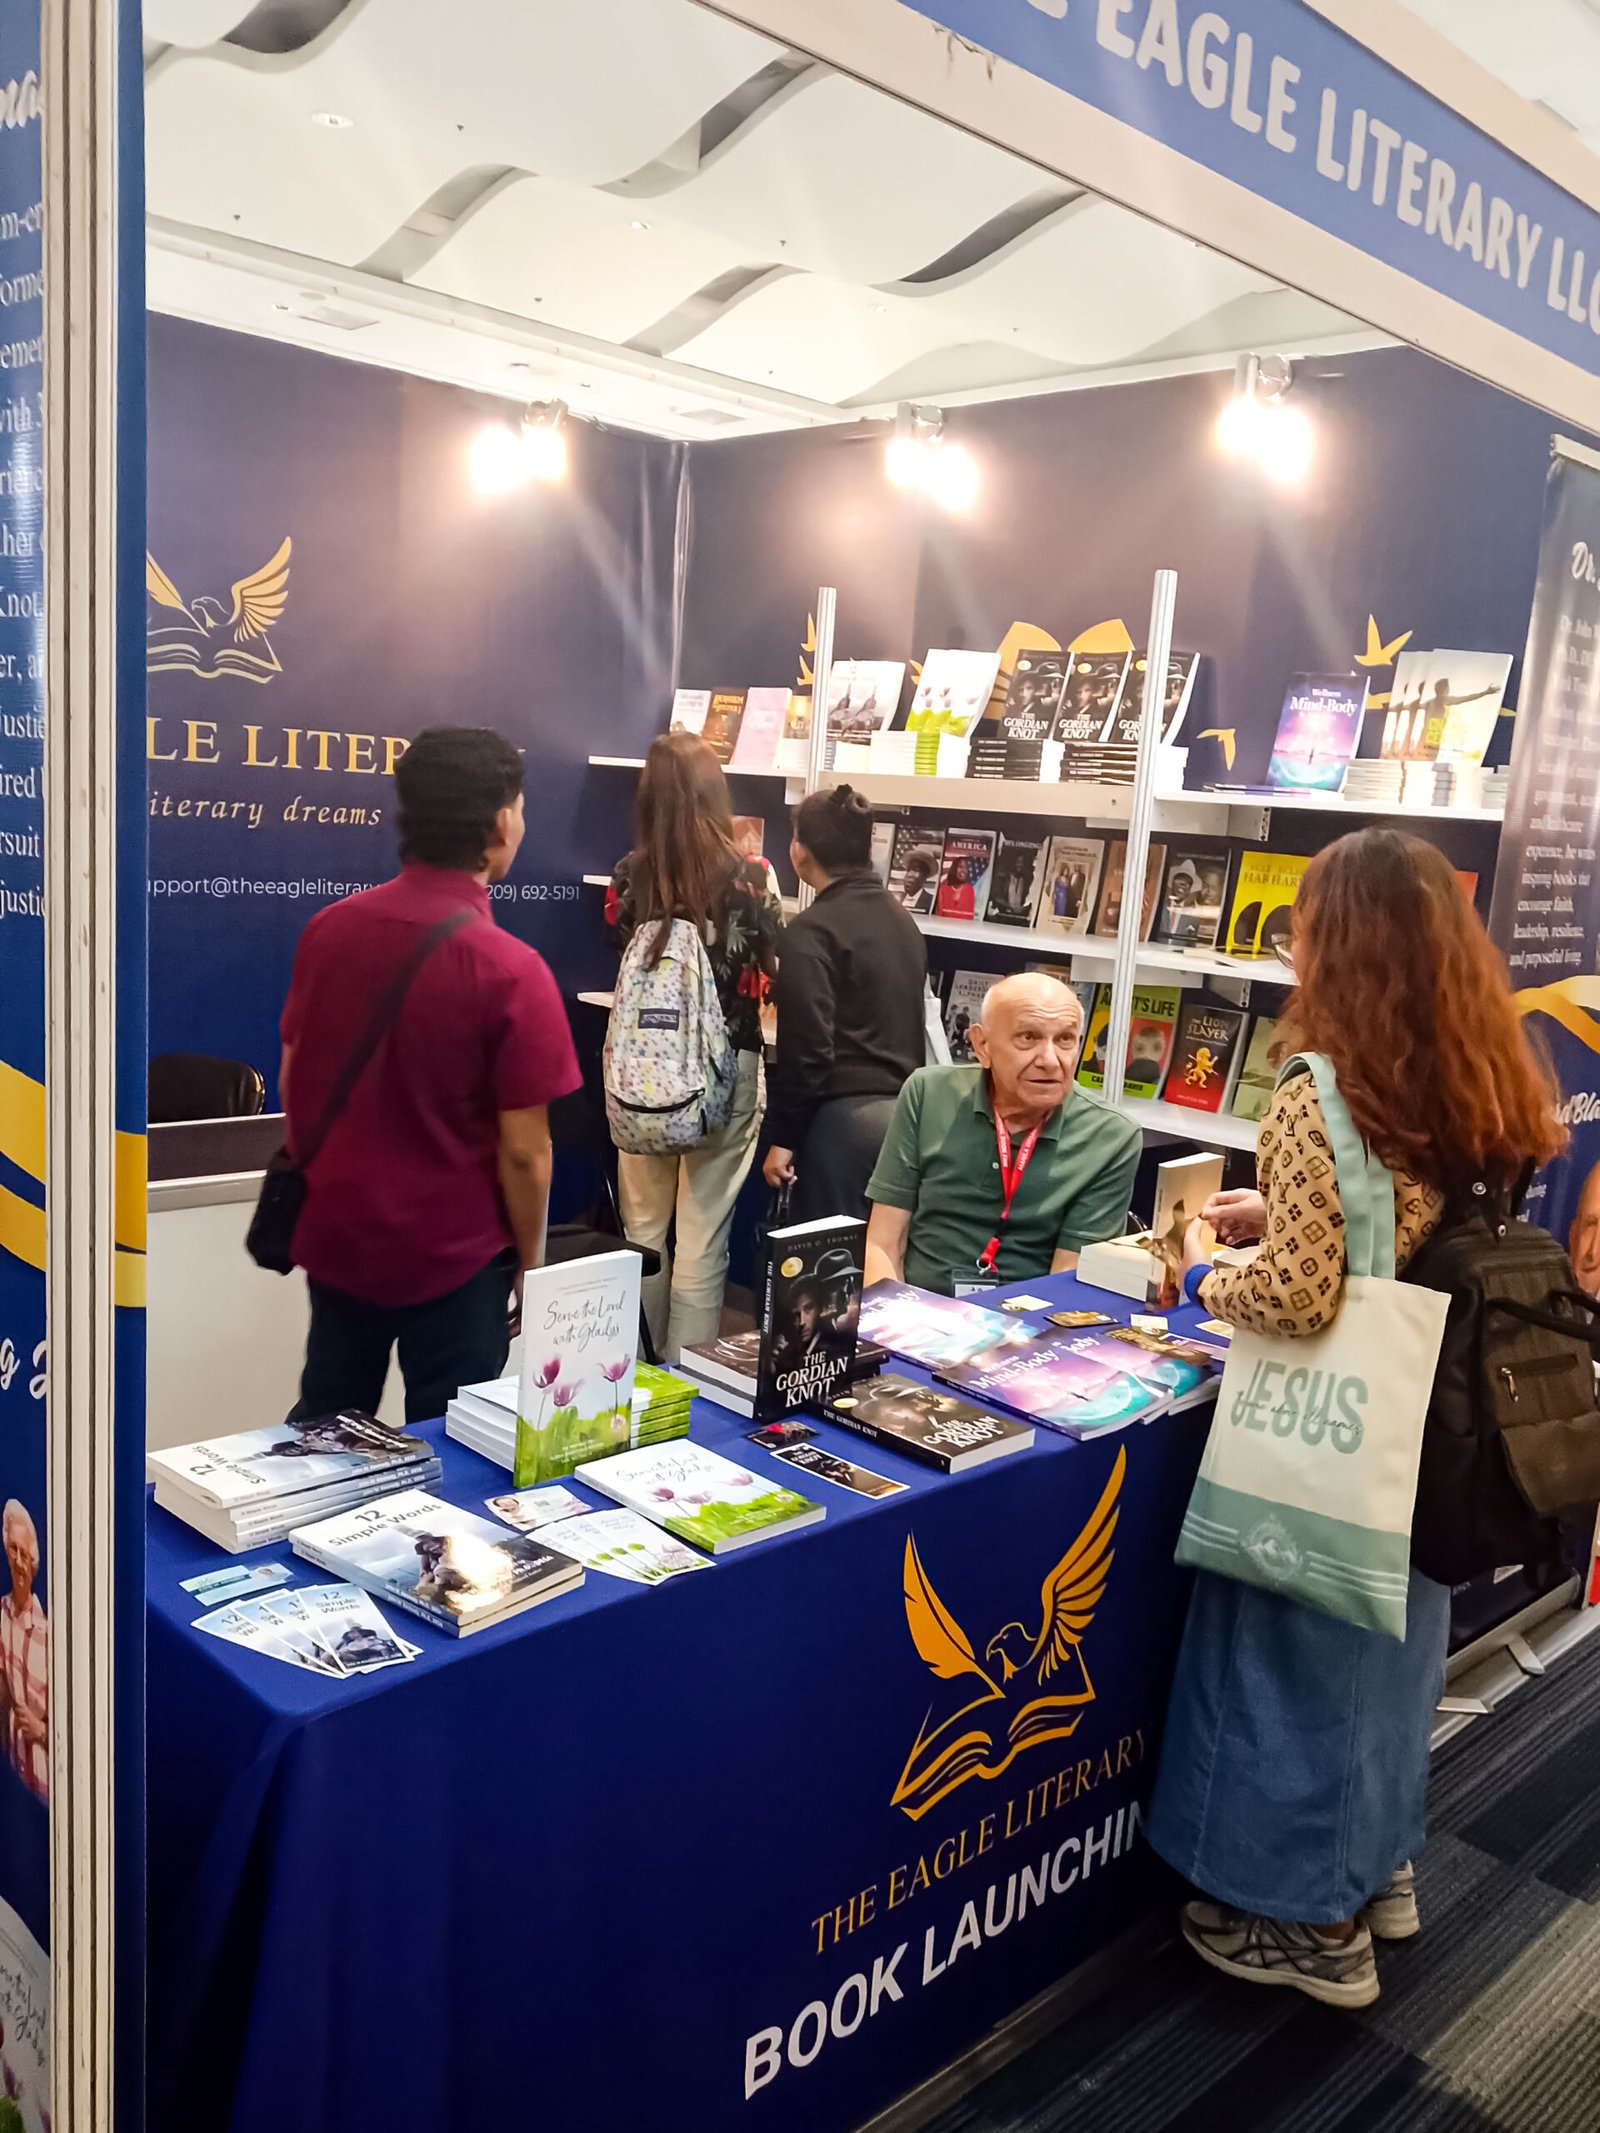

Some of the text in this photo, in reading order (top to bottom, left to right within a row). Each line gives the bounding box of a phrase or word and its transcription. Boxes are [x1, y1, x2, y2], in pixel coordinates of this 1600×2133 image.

[1096, 0, 1300, 153] EAGLE
[1316, 88, 1542, 289] LITERARY
[1290, 696, 1358, 717] Mind-Body
[282, 796, 382, 827] dreams
[521, 884, 580, 900] 692-5191
[1151, 1000, 1175, 1017] LIFE
[1187, 1024, 1230, 1042] SLAYER
[1202, 1016, 1227, 1028] LION
[803, 1351, 827, 1367] THE
[968, 1348, 1060, 1389] Mind-Body
[775, 1356, 849, 1392] GORDIAN
[785, 1376, 836, 1408] KNOT
[1230, 1358, 1369, 1455] JESUS
[923, 1415, 1000, 1445] GORDIAN
[947, 1425, 1004, 1448] KNOT
[328, 1504, 442, 1547] Simple Words
[354, 1509, 387, 1523] 12
[320, 1591, 341, 1601] 12
[221, 1613, 241, 1626] 12
[320, 1604, 361, 1614] Words
[811, 1729, 1146, 1955] THE EAGLE LITERARY
[744, 1942, 909, 2101] BOOK
